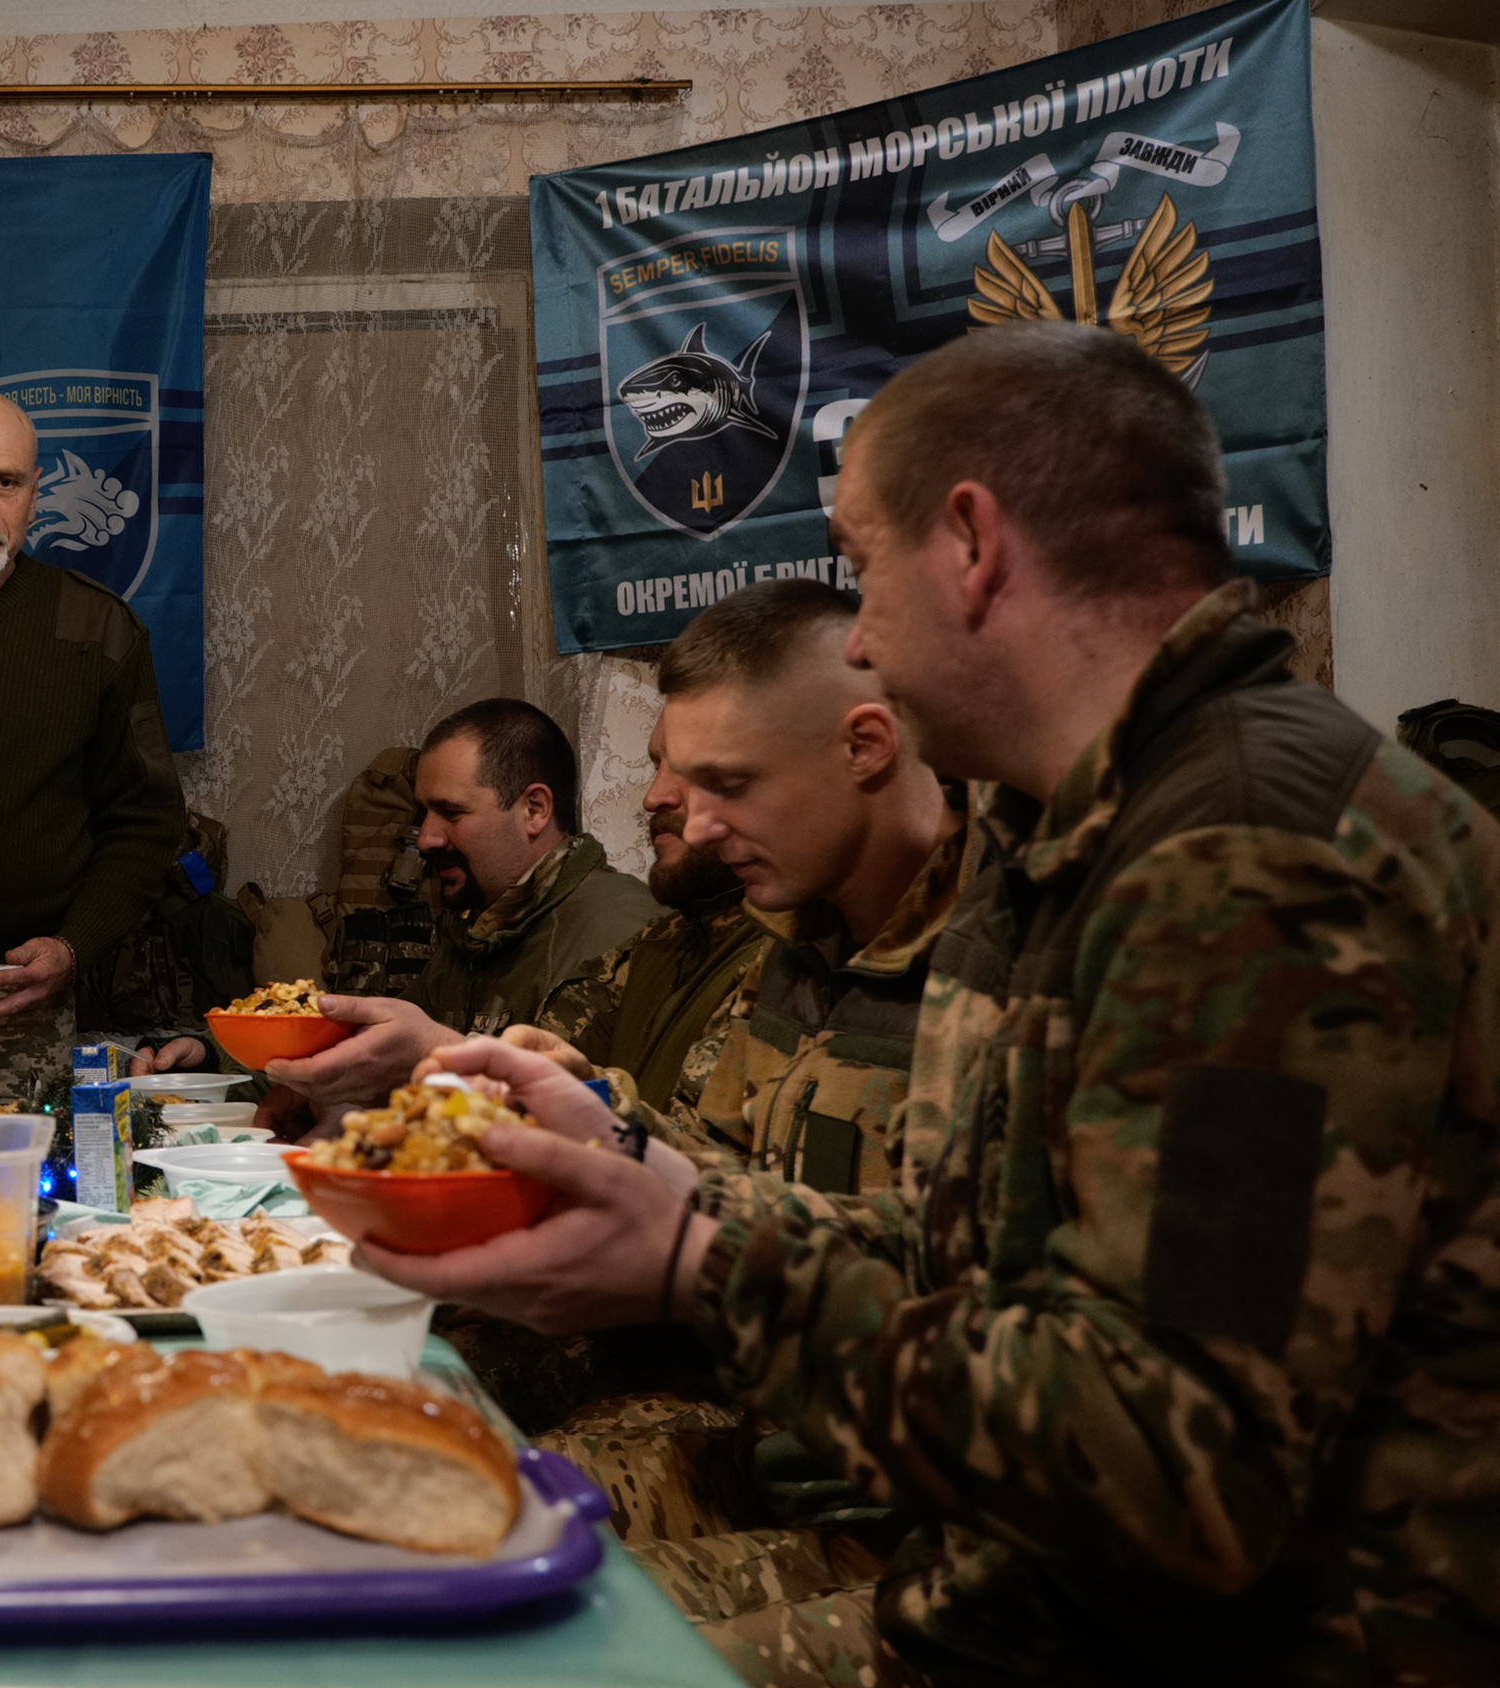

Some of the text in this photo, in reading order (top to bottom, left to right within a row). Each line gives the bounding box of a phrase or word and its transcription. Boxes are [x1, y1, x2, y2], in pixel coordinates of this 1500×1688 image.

[594, 37, 1234, 229] 1 БАТАЛЬЙОН МОРСЬКОЇ ПІХОТИ
[969, 137, 1199, 218] ВІРНИЙ ЗАВЖДИ
[609, 241, 780, 295] SEMPER FIDELIS
[21, 386, 57, 406] ЧЕСТЬ
[66, 385, 92, 403] МОЯ
[94, 386, 143, 407] ВІРНІСТЬ
[616, 560, 748, 616] ОКРЕМОЇ
